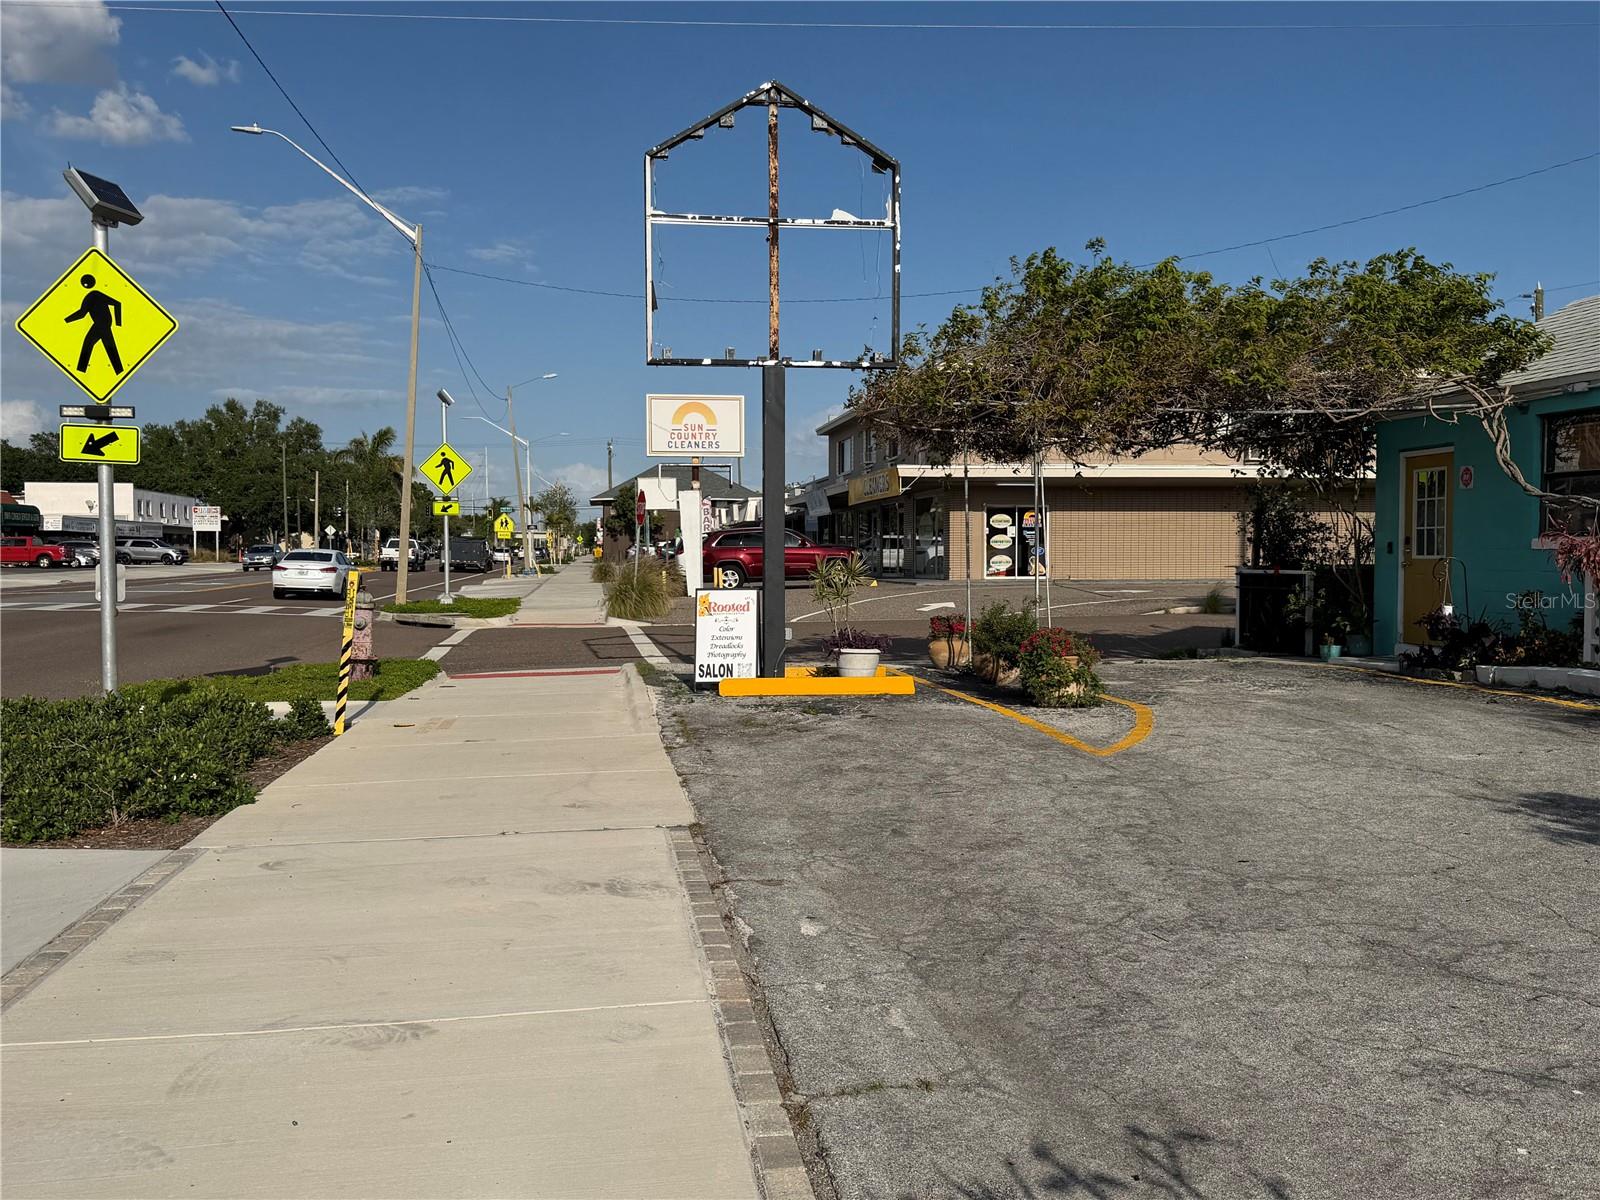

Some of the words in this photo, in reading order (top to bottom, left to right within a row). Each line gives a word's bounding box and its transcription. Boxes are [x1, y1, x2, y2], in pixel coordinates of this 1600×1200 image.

[683, 423, 704, 431] SUN
[669, 432, 718, 440] COUNTRY
[667, 441, 720, 449] CLEANERS
[703, 507, 711, 531] BAR
[708, 601, 750, 612] Rooted
[710, 642, 744, 650] Dreadlocks
[706, 650, 747, 660] Photography
[698, 663, 734, 678] SALON
